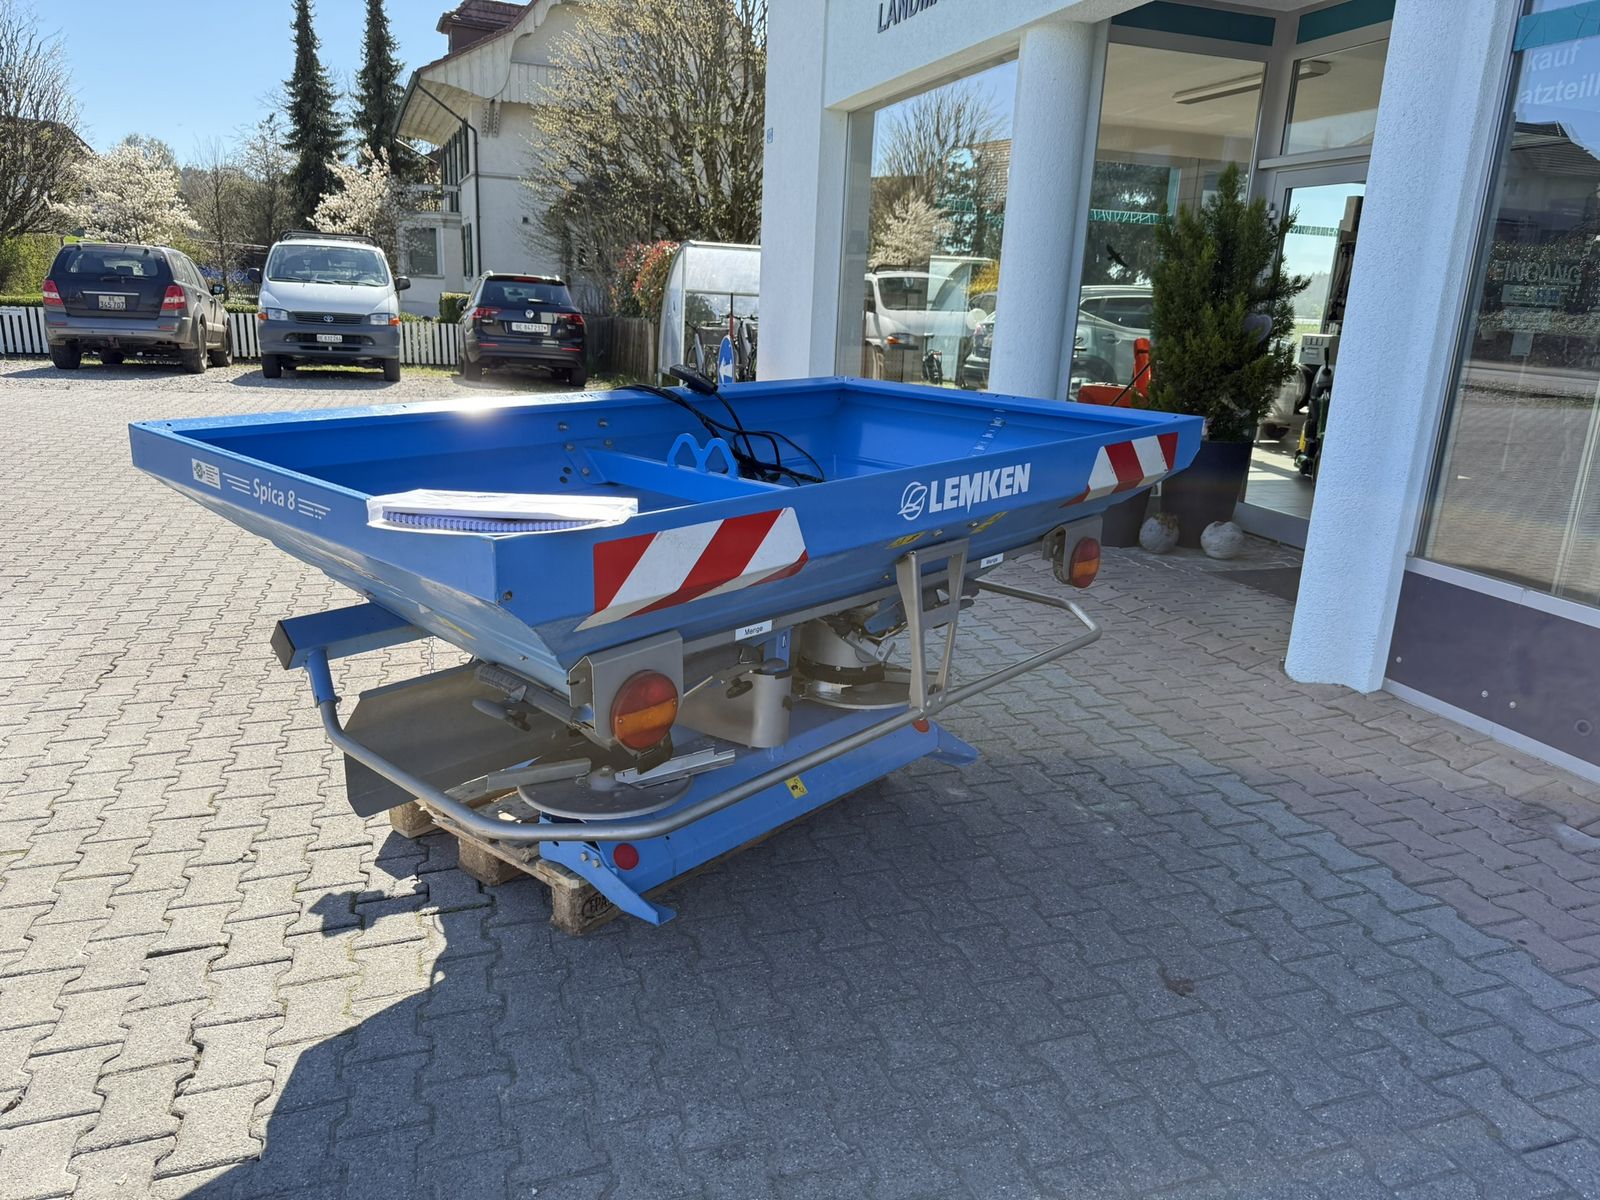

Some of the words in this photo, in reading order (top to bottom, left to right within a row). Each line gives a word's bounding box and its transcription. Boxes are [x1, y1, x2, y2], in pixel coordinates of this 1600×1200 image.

[1493, 259, 1582, 285] EINGANG
[253, 478, 284, 507] Spica
[287, 490, 295, 510] 8
[929, 462, 1031, 514] LEMKEN
[744, 625, 764, 636] Menge
